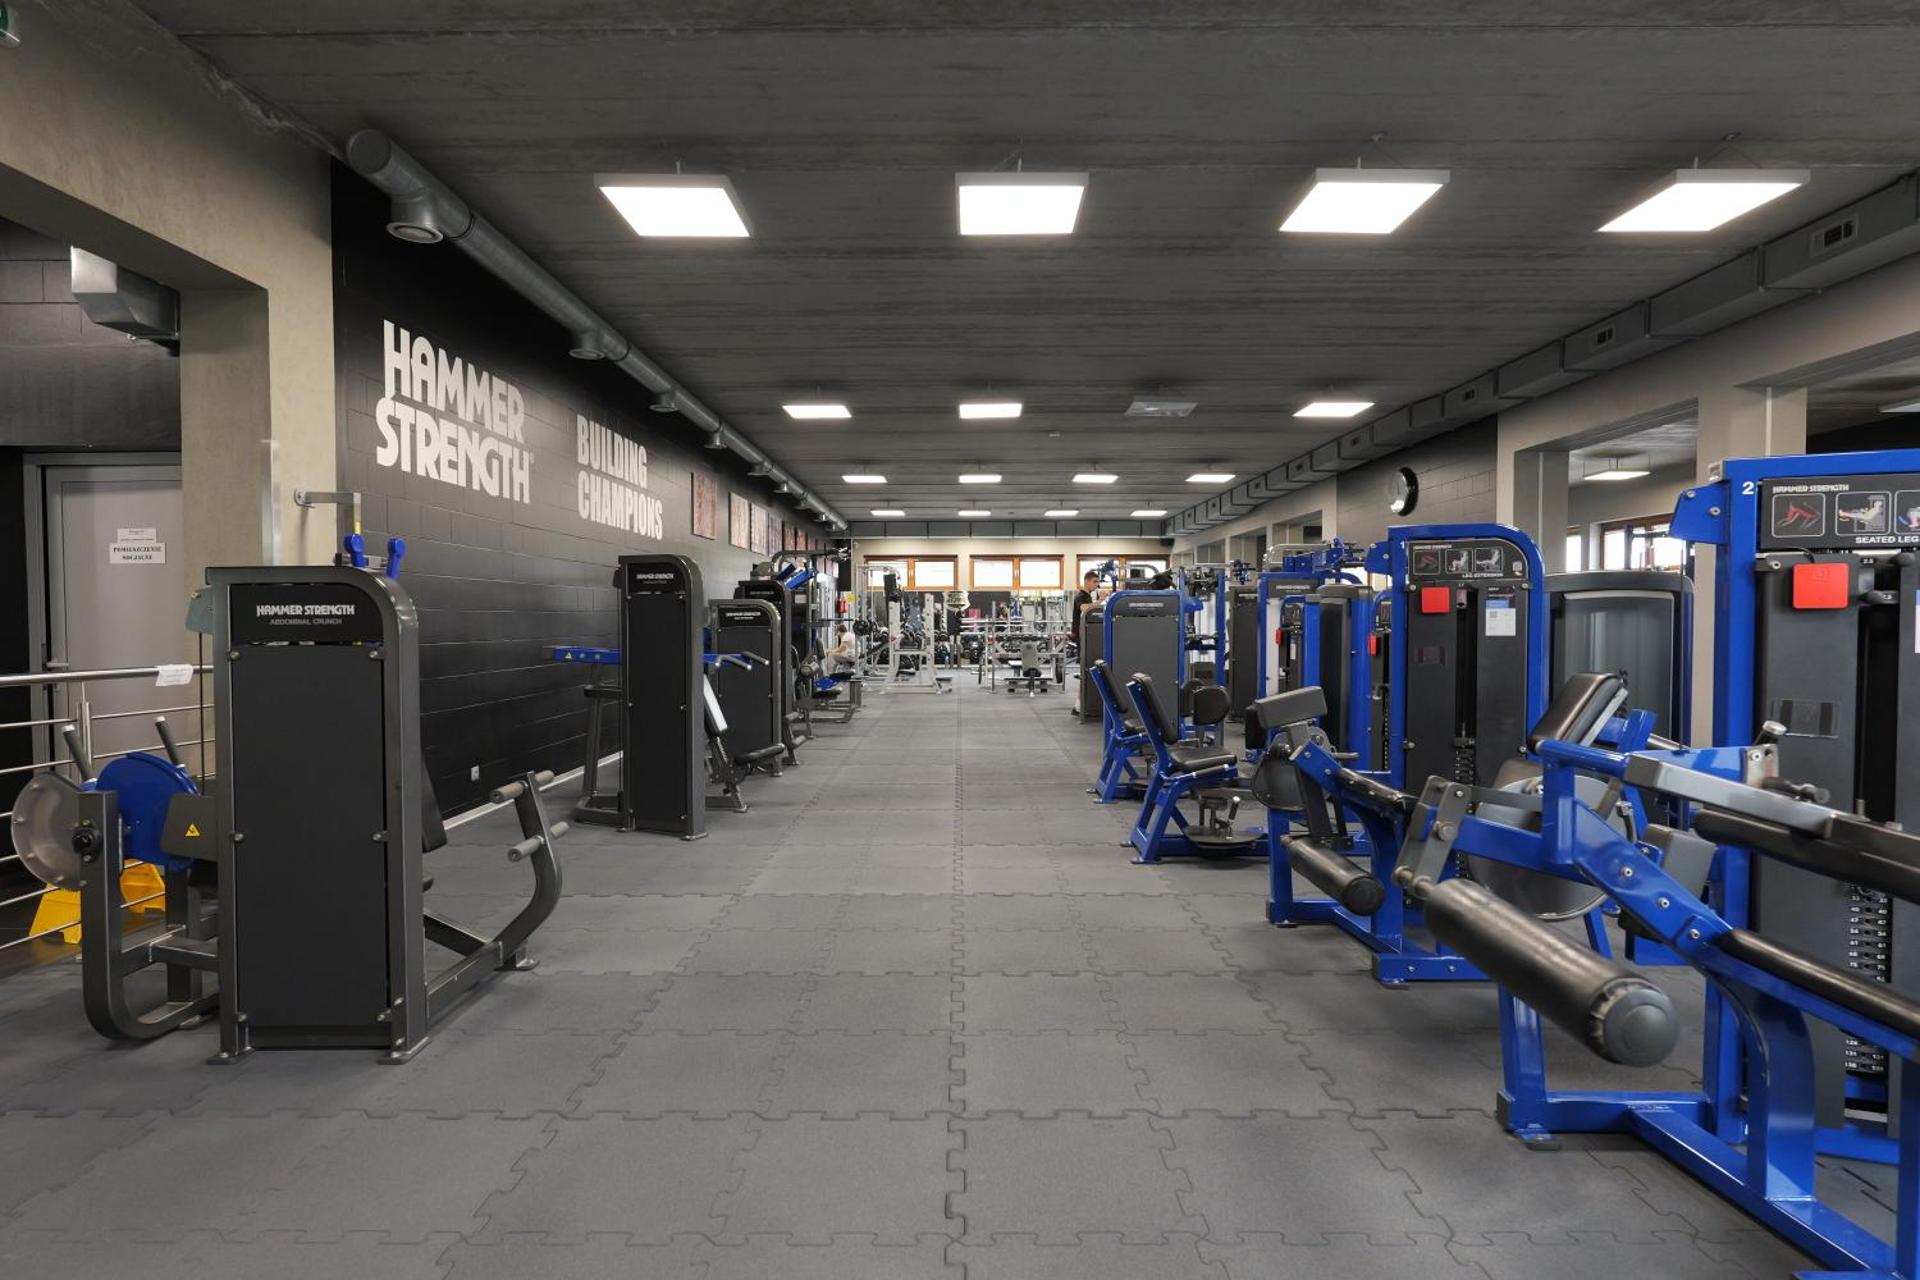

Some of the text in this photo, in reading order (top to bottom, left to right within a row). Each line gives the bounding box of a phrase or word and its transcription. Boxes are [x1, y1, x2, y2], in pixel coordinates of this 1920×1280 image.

[383, 319, 525, 444] HAMMER
[375, 397, 531, 505] STRENGTH
[576, 414, 648, 489] BUILDING
[577, 470, 664, 540] CHAMPIONS
[1742, 481, 1754, 495] 2
[1809, 484, 1849, 492] STRENGTH
[1855, 535, 1919, 544] SEATED LEG
[256, 604, 355, 617] HAMMER STRENGTH
